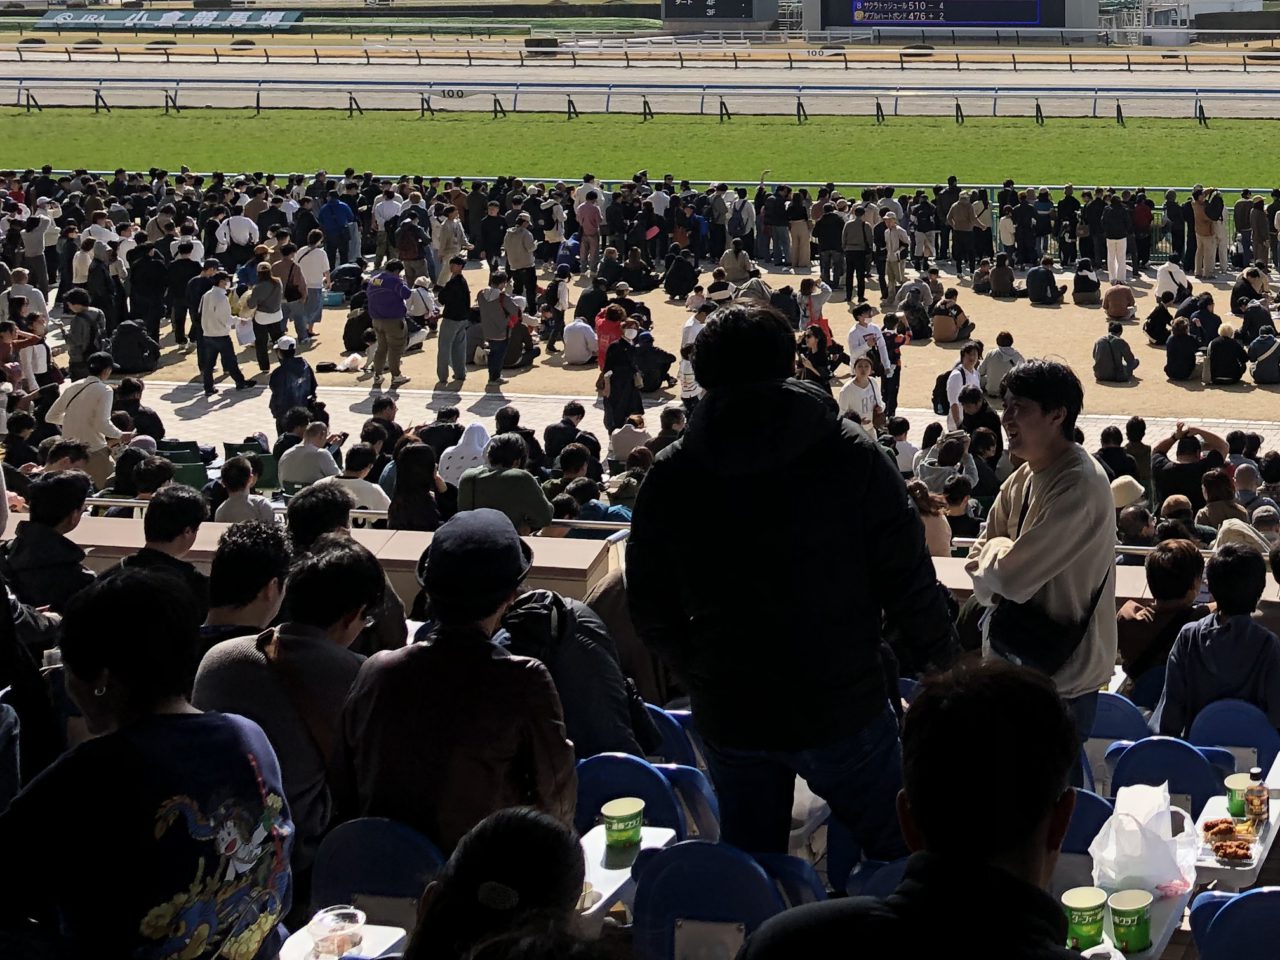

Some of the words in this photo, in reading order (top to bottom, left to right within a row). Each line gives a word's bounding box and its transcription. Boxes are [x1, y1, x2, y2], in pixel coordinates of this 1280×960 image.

[908, 2, 926, 10] 510
[908, 12, 926, 20] 476
[441, 89, 464, 98] 100
